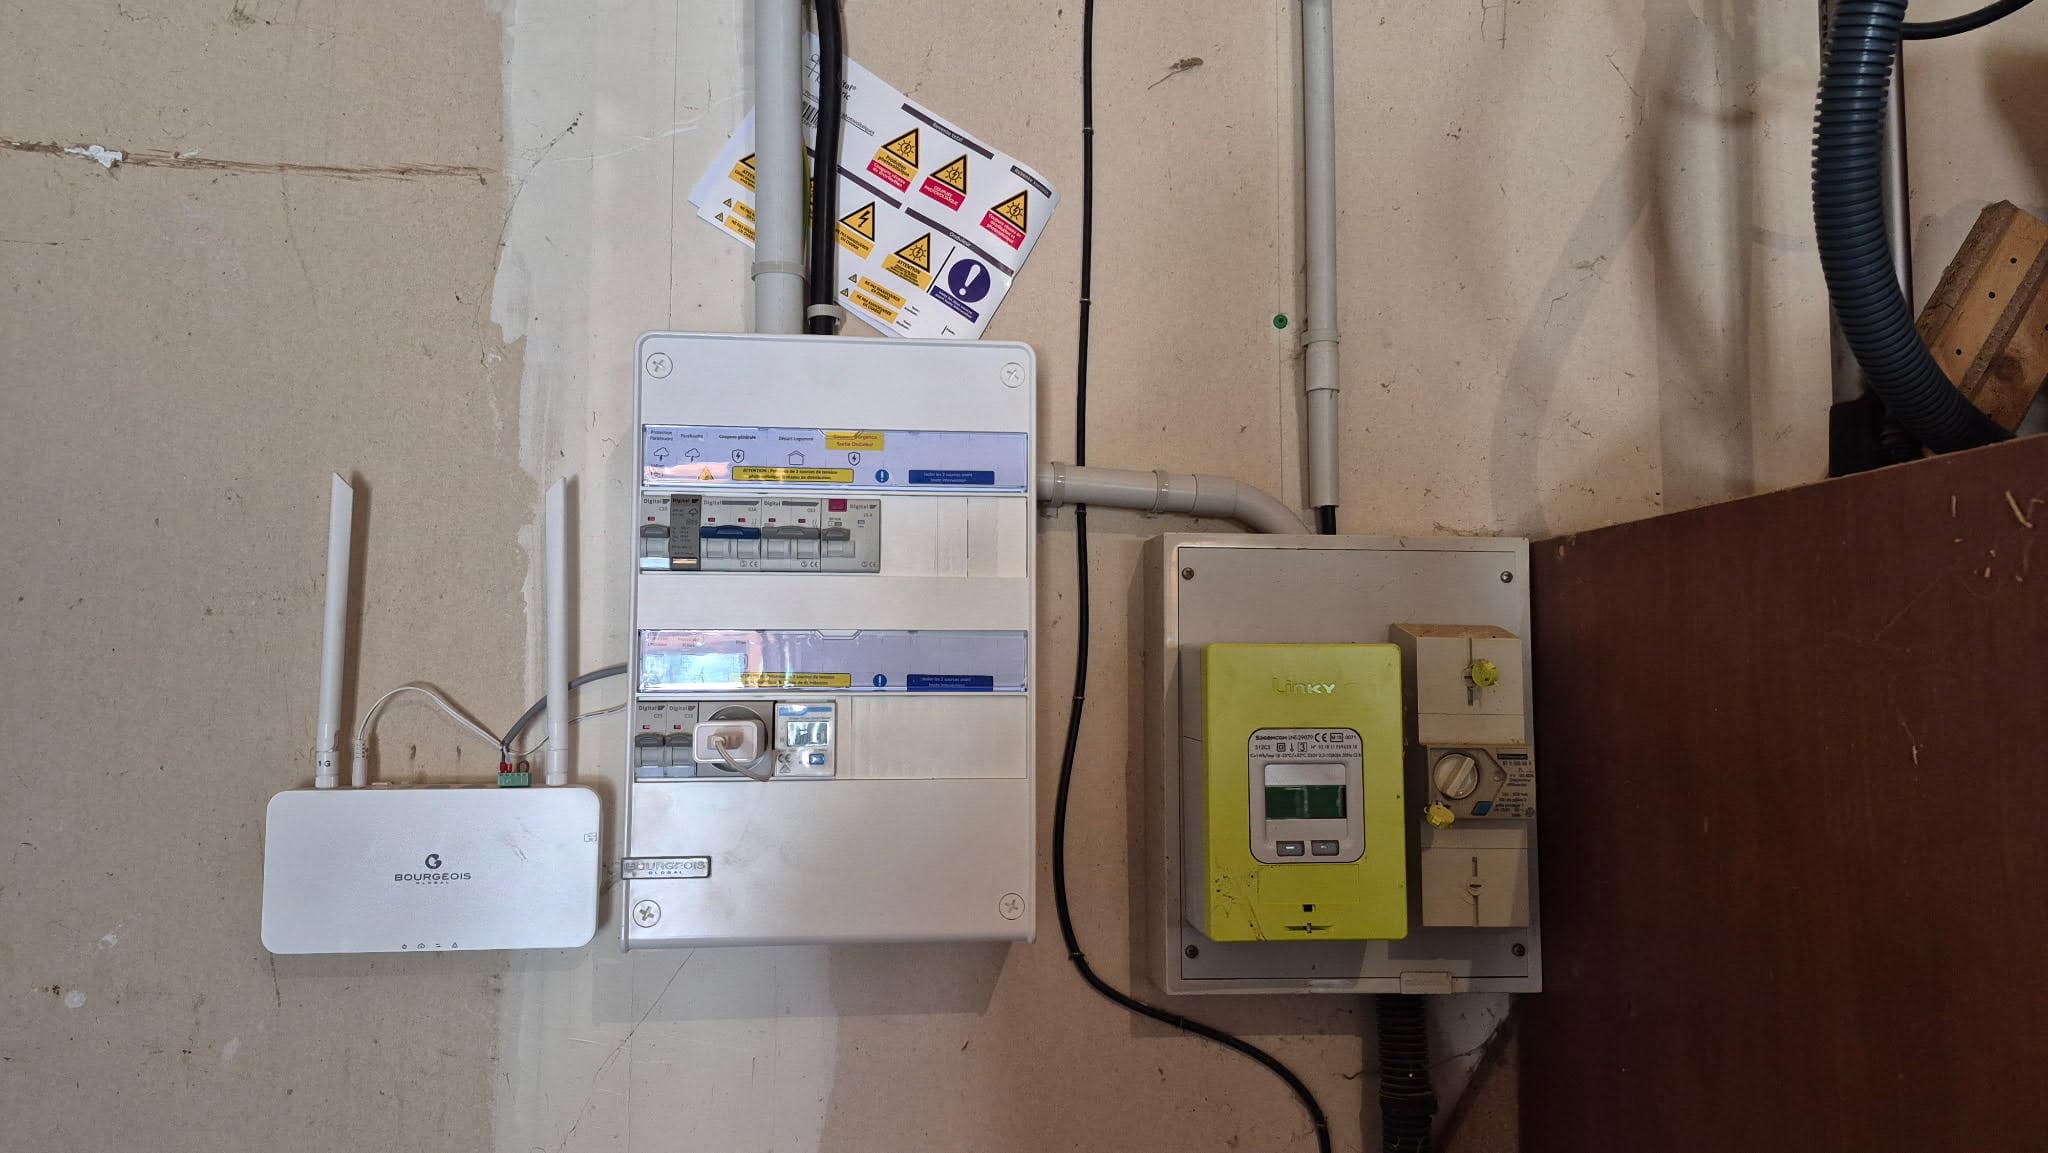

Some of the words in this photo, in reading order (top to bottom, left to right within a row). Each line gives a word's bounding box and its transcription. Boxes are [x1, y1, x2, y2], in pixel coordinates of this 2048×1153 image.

[896, 259, 921, 274] ATTENTION
[623, 862, 705, 871] BOURGEOIS
[394, 872, 472, 881] BOURGEOIS
